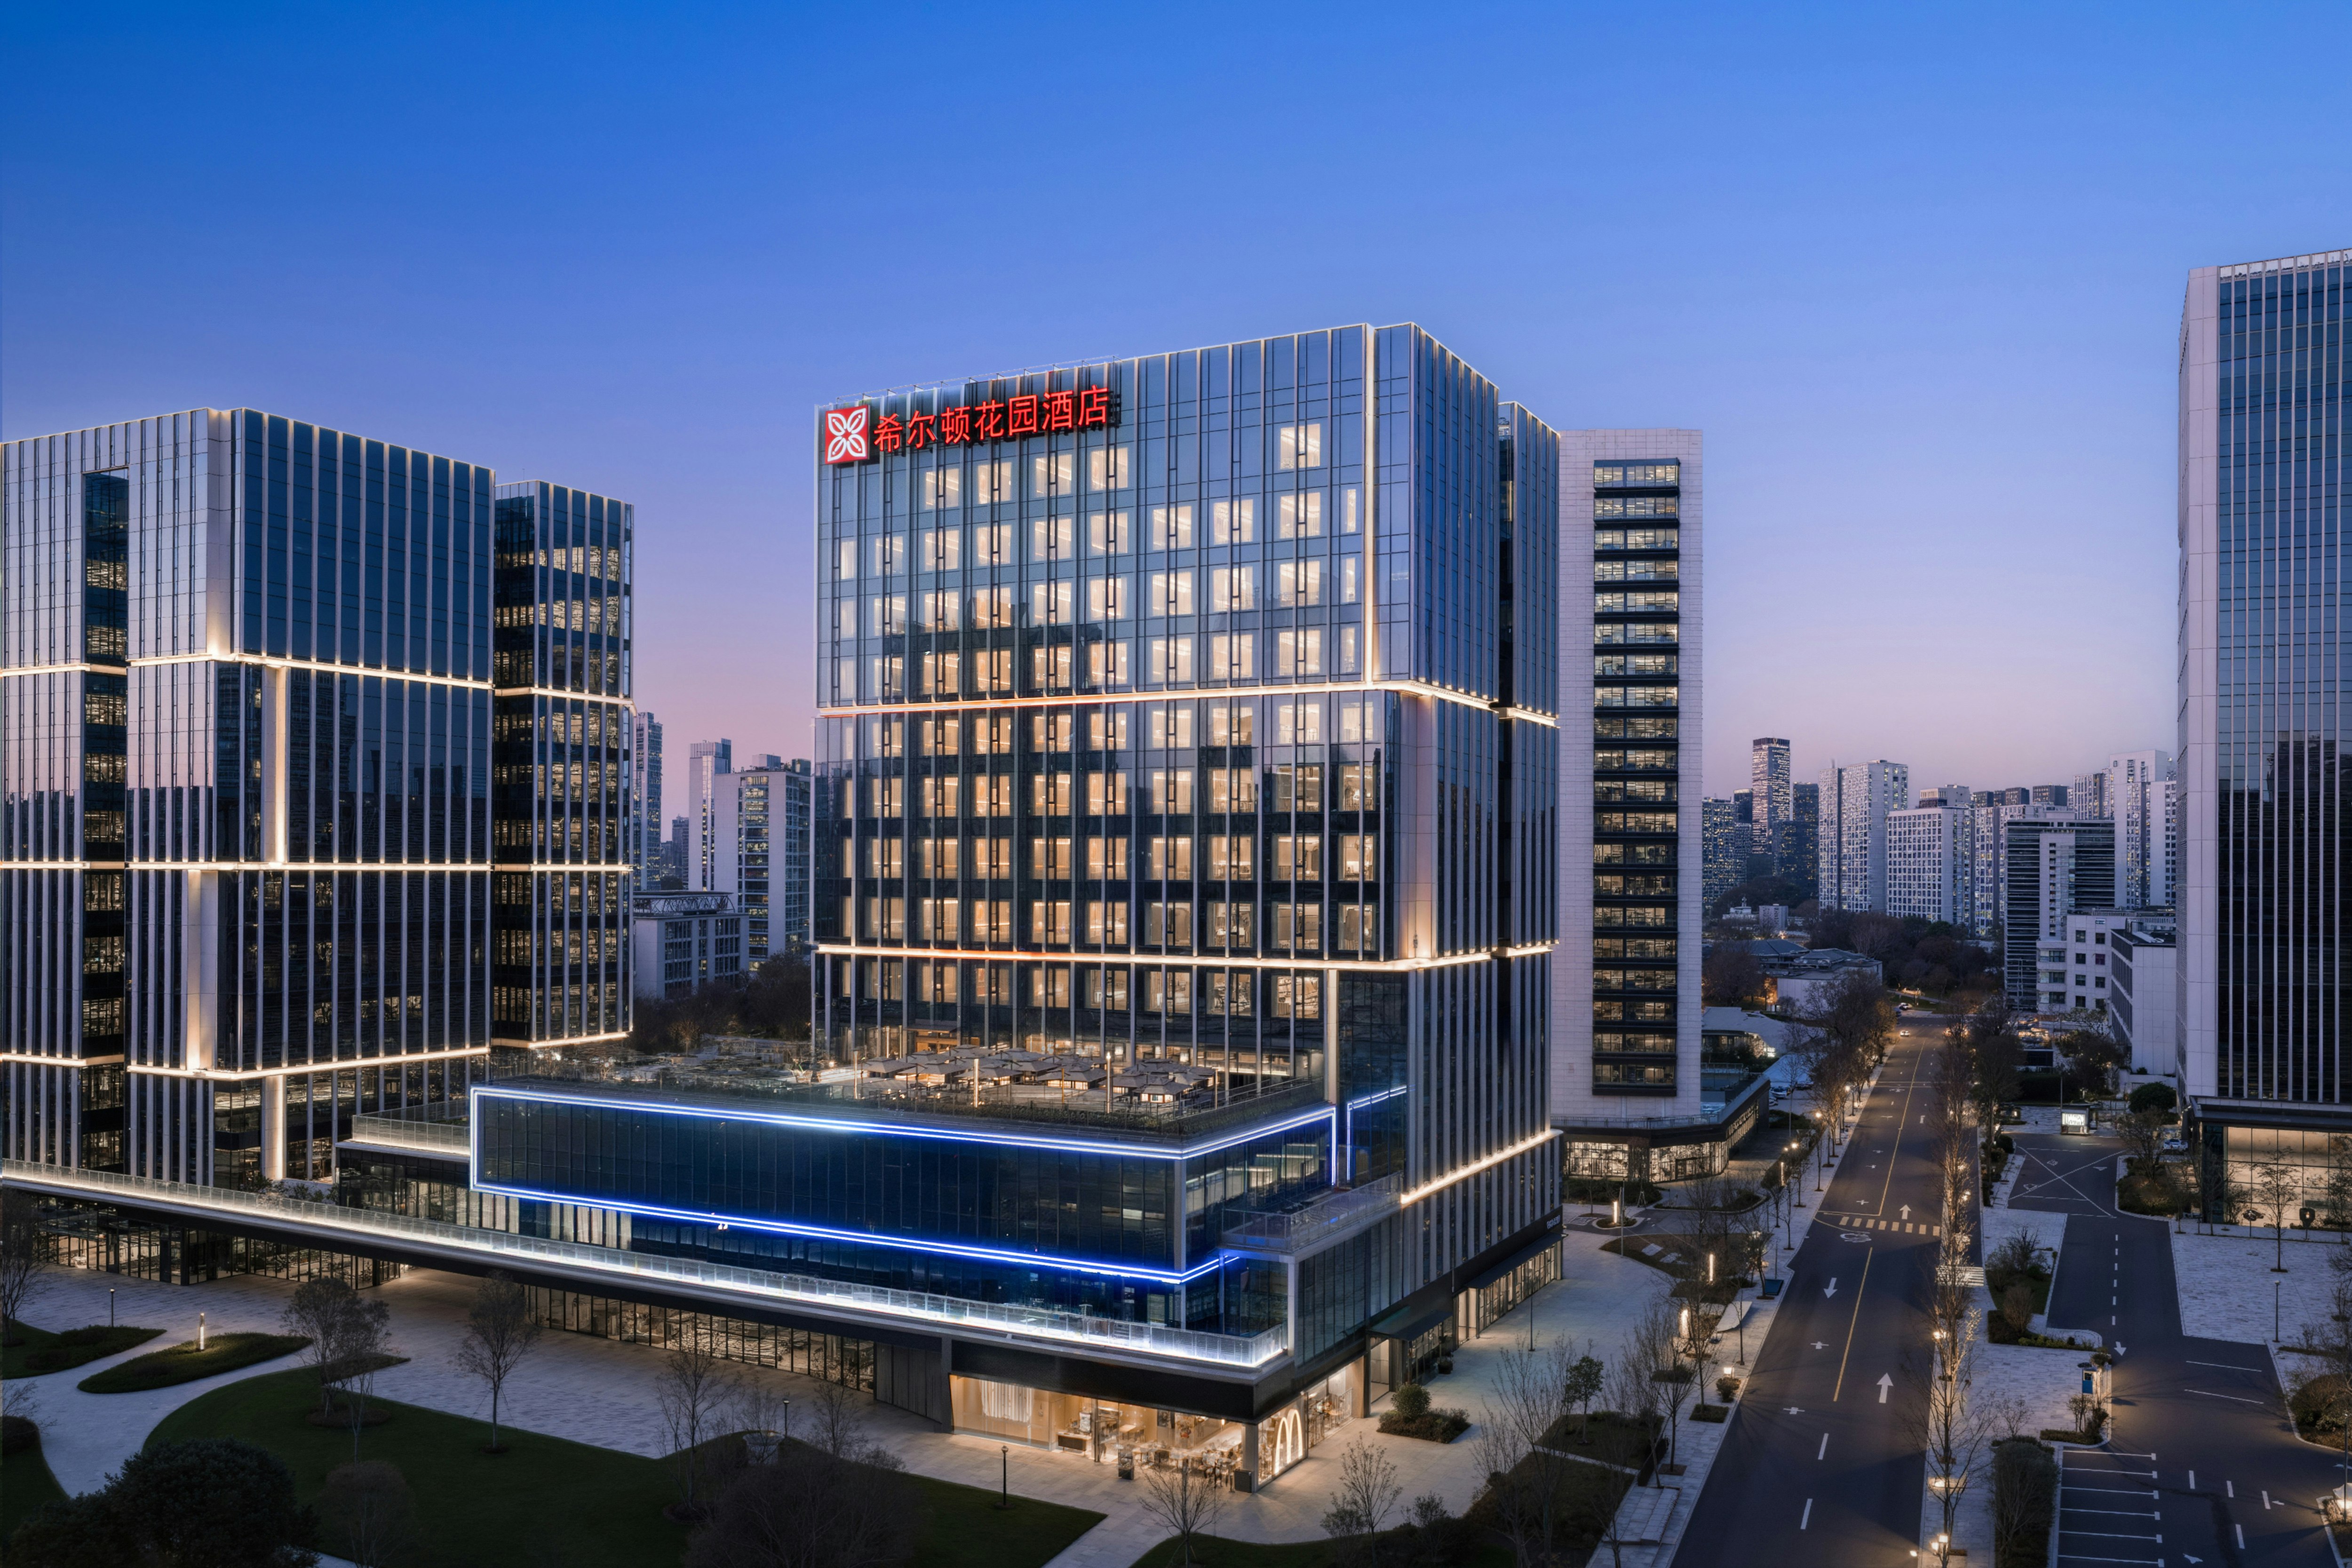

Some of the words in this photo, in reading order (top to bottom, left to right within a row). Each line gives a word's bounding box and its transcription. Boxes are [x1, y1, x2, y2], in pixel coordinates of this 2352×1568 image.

[874, 384, 1109, 453] 希尔顿花园酒店
